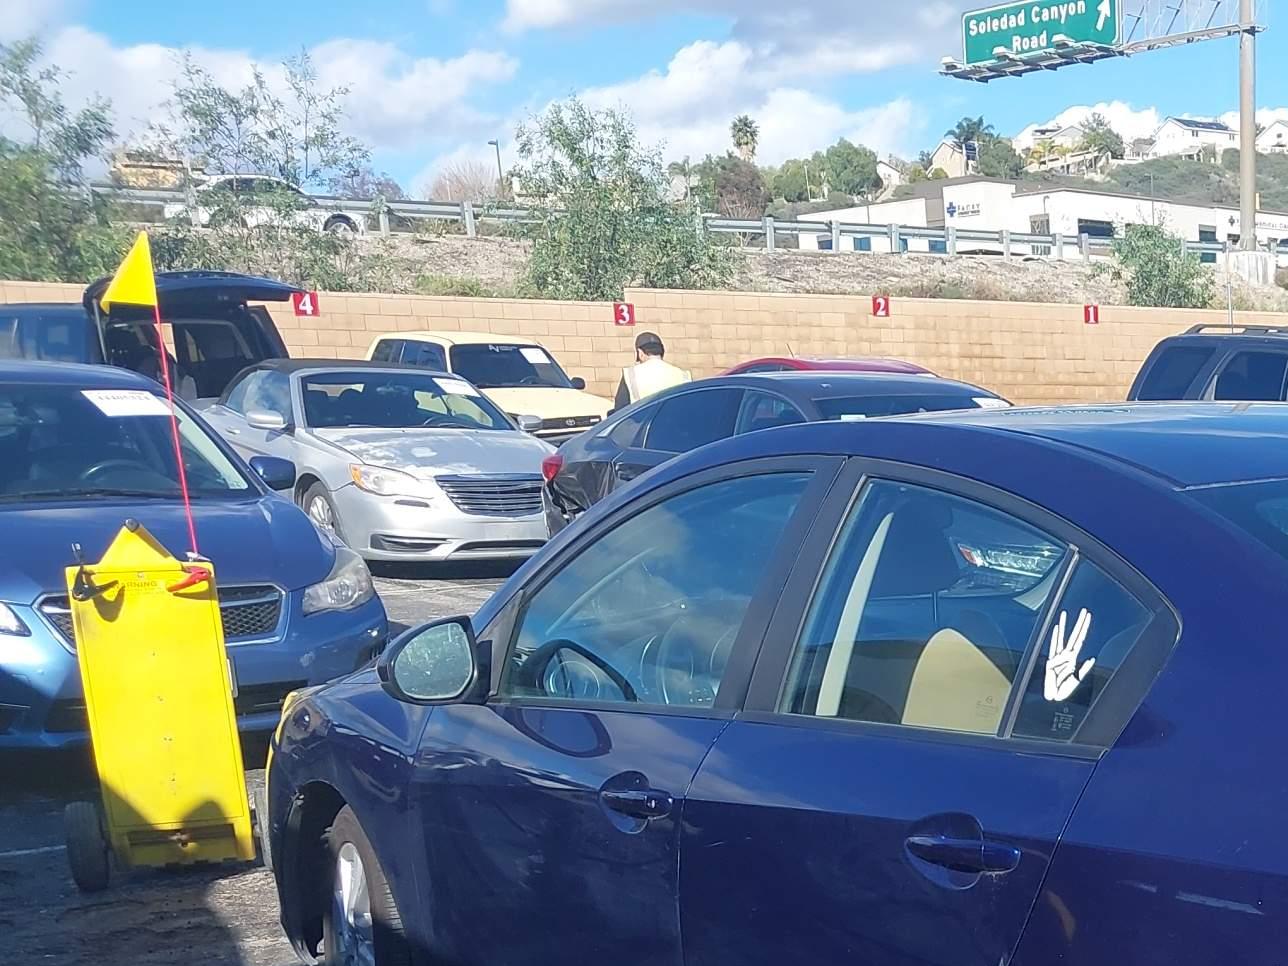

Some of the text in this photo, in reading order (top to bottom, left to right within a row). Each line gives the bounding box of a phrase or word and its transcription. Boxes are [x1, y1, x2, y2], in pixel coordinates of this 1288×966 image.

[969, 0, 1086, 36] Soledad Canyon
[1012, 30, 1047, 51] Road
[298, 293, 314, 315] 4
[618, 304, 630, 324] 3
[876, 297, 886, 316] 2
[1087, 305, 1097, 324] 1
